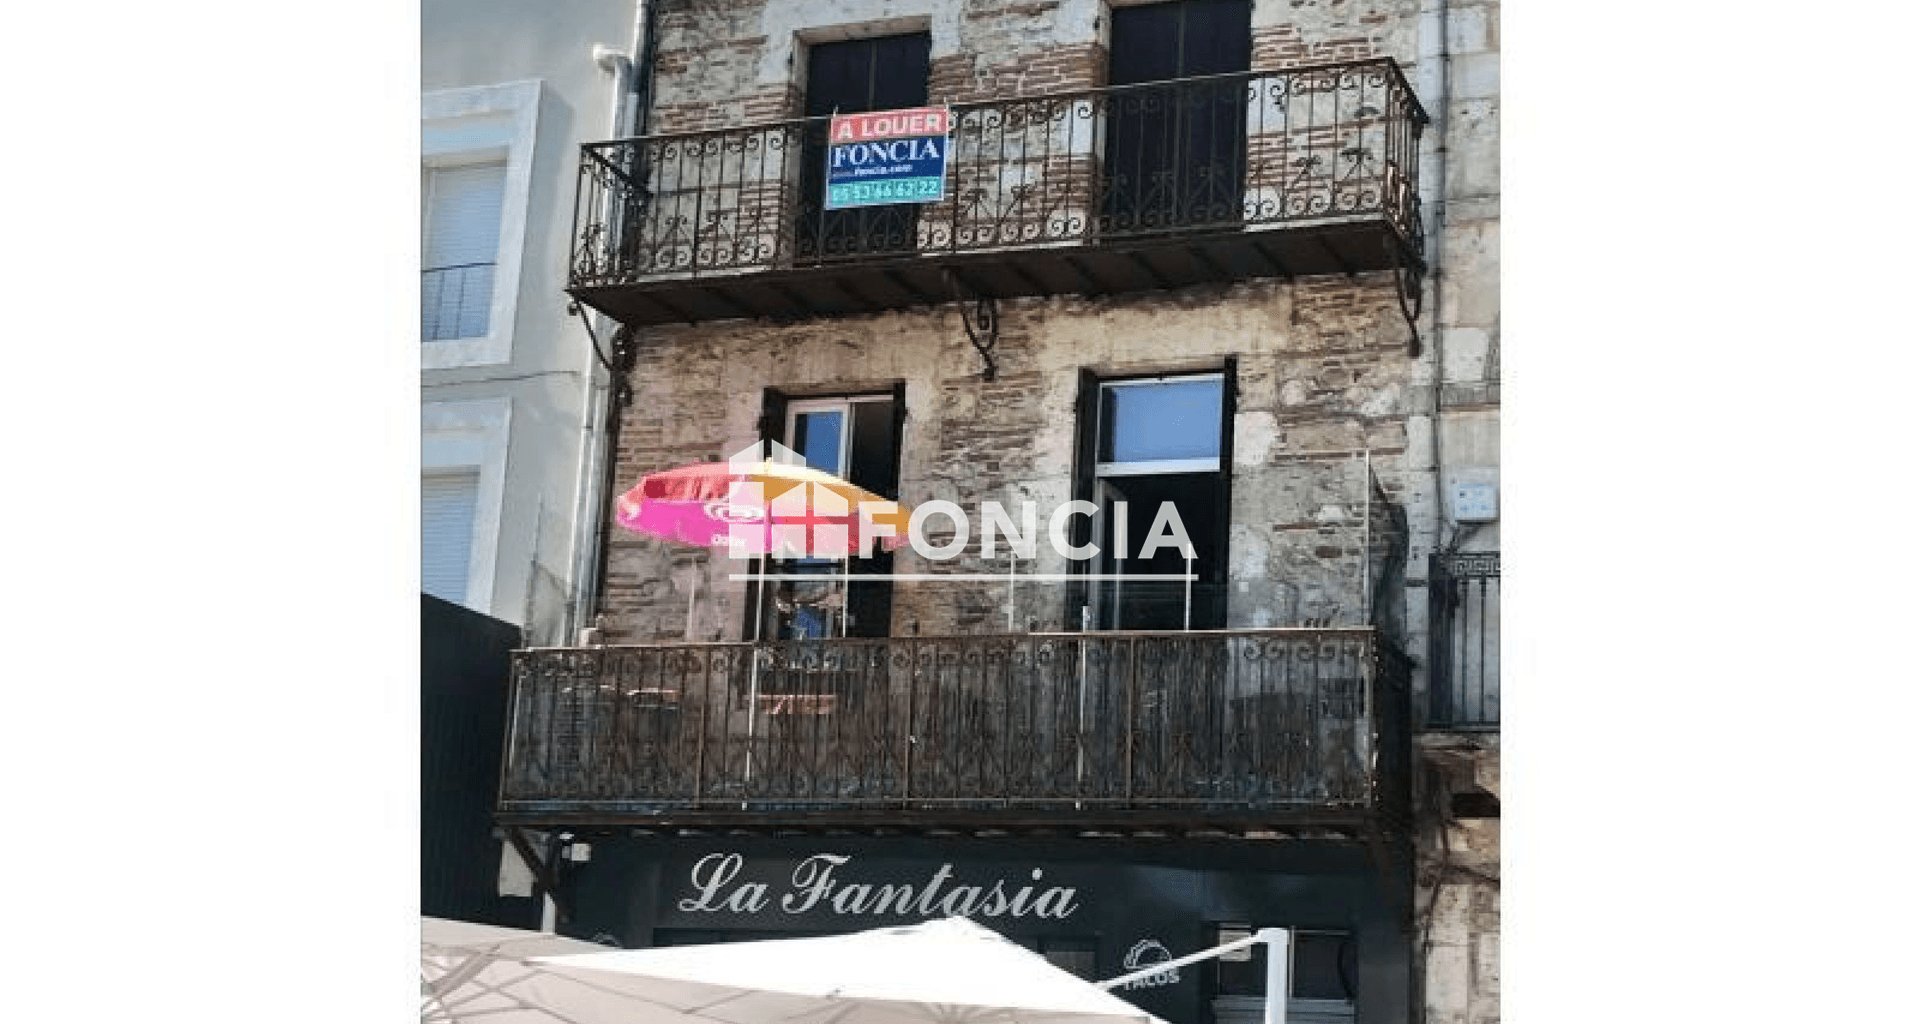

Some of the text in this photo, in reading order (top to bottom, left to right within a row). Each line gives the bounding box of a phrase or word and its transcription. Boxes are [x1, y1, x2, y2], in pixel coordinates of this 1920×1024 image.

[838, 113, 942, 140] A LOUER
[833, 138, 940, 168] FONCIA
[678, 853, 1079, 918] La Fantasia
